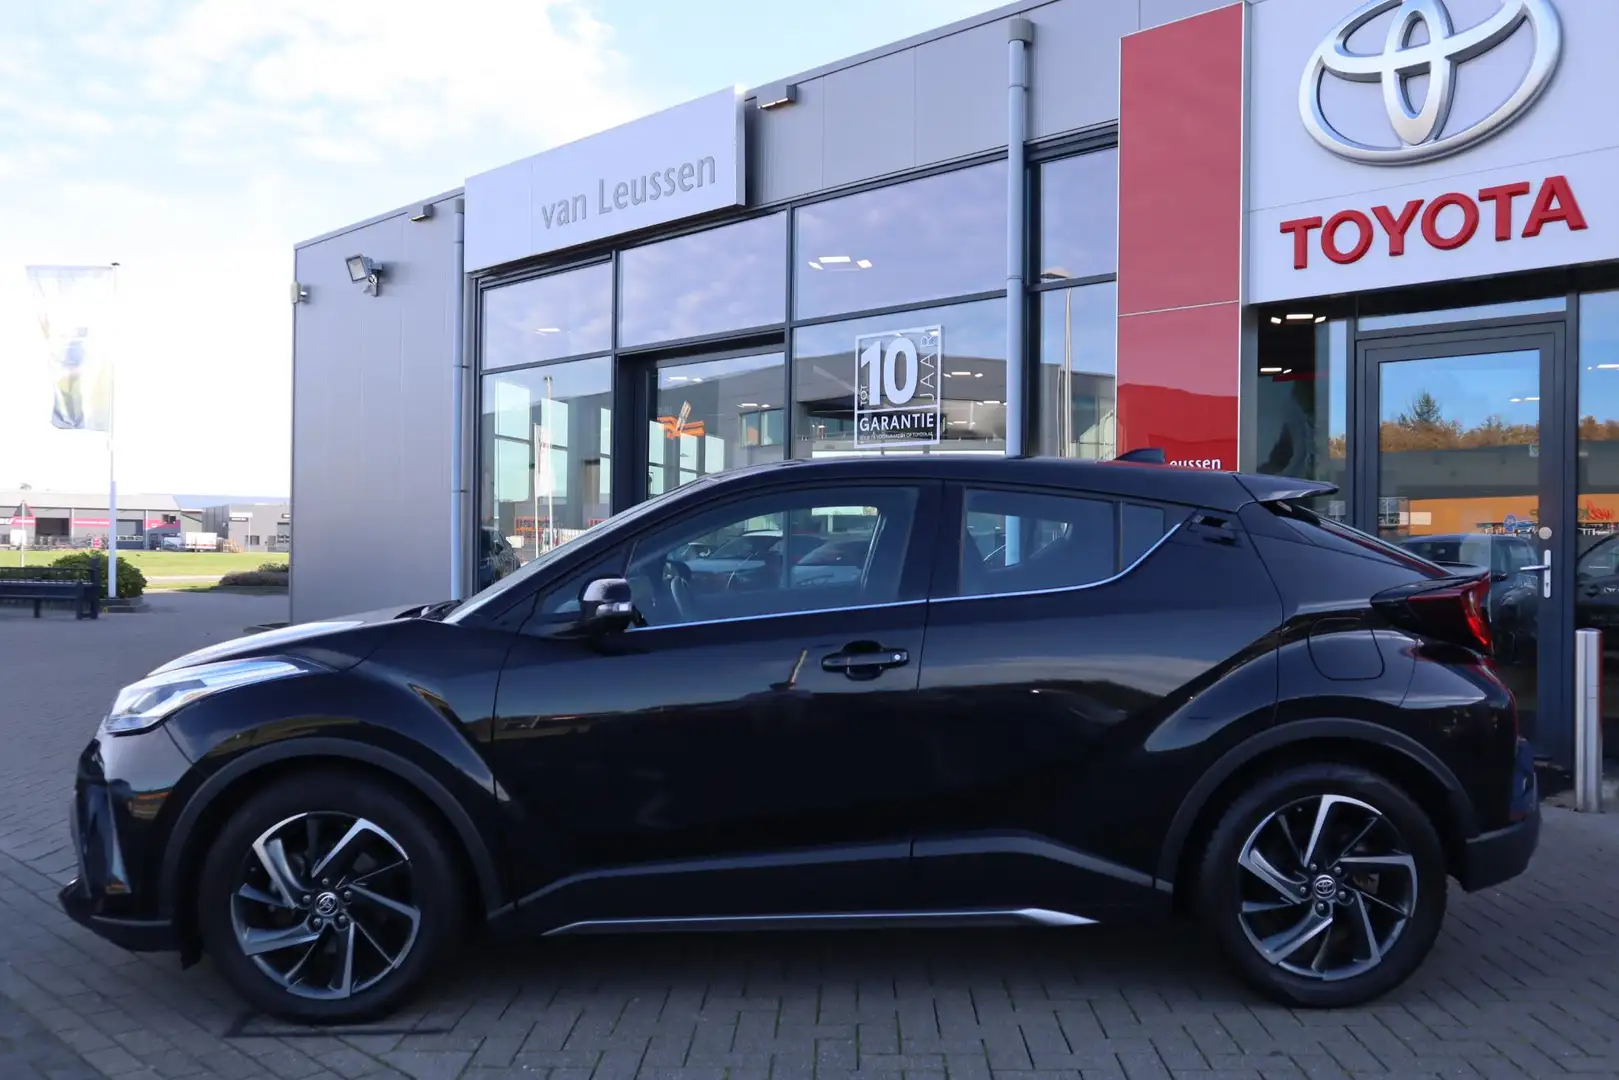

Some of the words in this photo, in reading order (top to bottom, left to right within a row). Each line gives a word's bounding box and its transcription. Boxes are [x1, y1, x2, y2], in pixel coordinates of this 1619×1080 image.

[541, 193, 587, 230] van
[598, 155, 716, 216] Leussen
[1279, 174, 1589, 271] TOYOTA
[860, 337, 918, 406] 10
[860, 384, 868, 406] TOT
[919, 335, 937, 402] JAAR
[859, 412, 935, 432] GARANTIE
[1169, 459, 1221, 470] eussen
